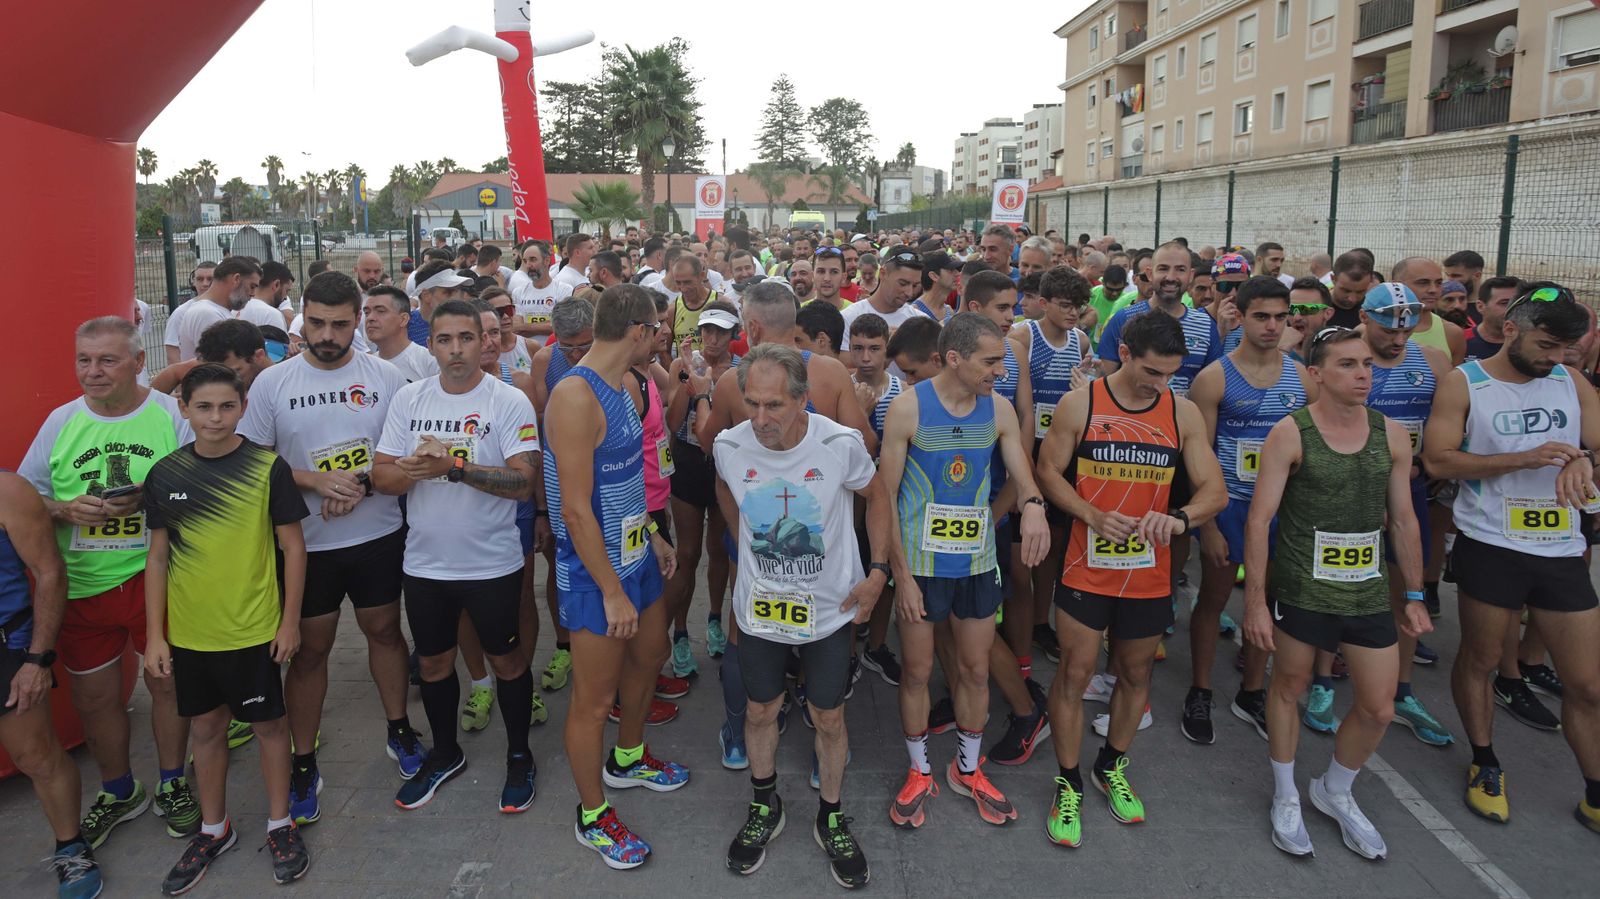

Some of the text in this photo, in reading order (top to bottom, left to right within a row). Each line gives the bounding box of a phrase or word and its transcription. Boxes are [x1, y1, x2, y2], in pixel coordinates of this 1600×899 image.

[318, 448, 368, 472] 132
[1093, 443, 1169, 467] atletismo
[601, 461, 624, 473] Club
[1093, 465, 1166, 481] LOS BARRIOS
[169, 492, 188, 500] FILA
[931, 518, 979, 538] 239
[1523, 510, 1560, 528] 80
[780, 554, 795, 575] la
[796, 553, 825, 576] vida
[1323, 546, 1373, 566] 299
[754, 600, 808, 623] 316
